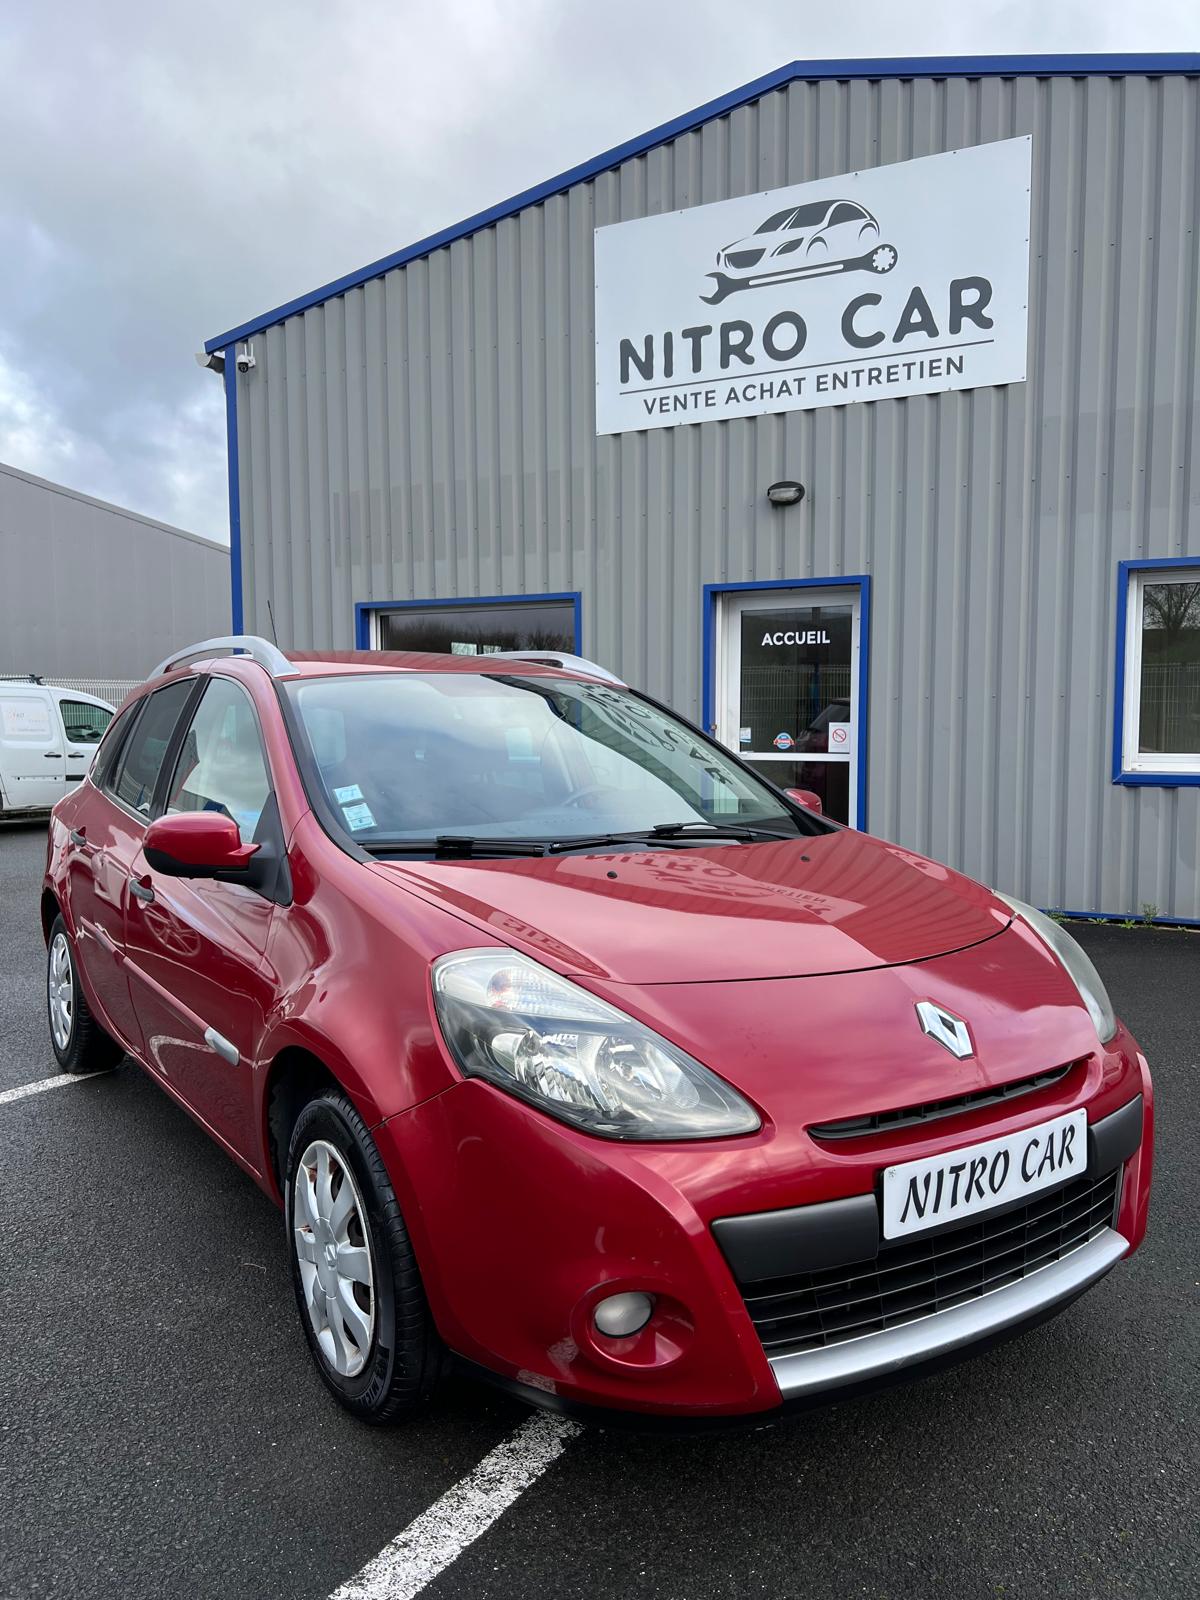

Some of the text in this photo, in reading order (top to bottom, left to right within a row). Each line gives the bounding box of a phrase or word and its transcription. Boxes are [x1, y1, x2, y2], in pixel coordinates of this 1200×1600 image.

[619, 275, 995, 385] NITRO CAR
[643, 355, 964, 416] VENTE ACHAT ENTRETIEN
[761, 630, 831, 646] ACCUEIL
[899, 1124, 1076, 1224] NITRO CAR
